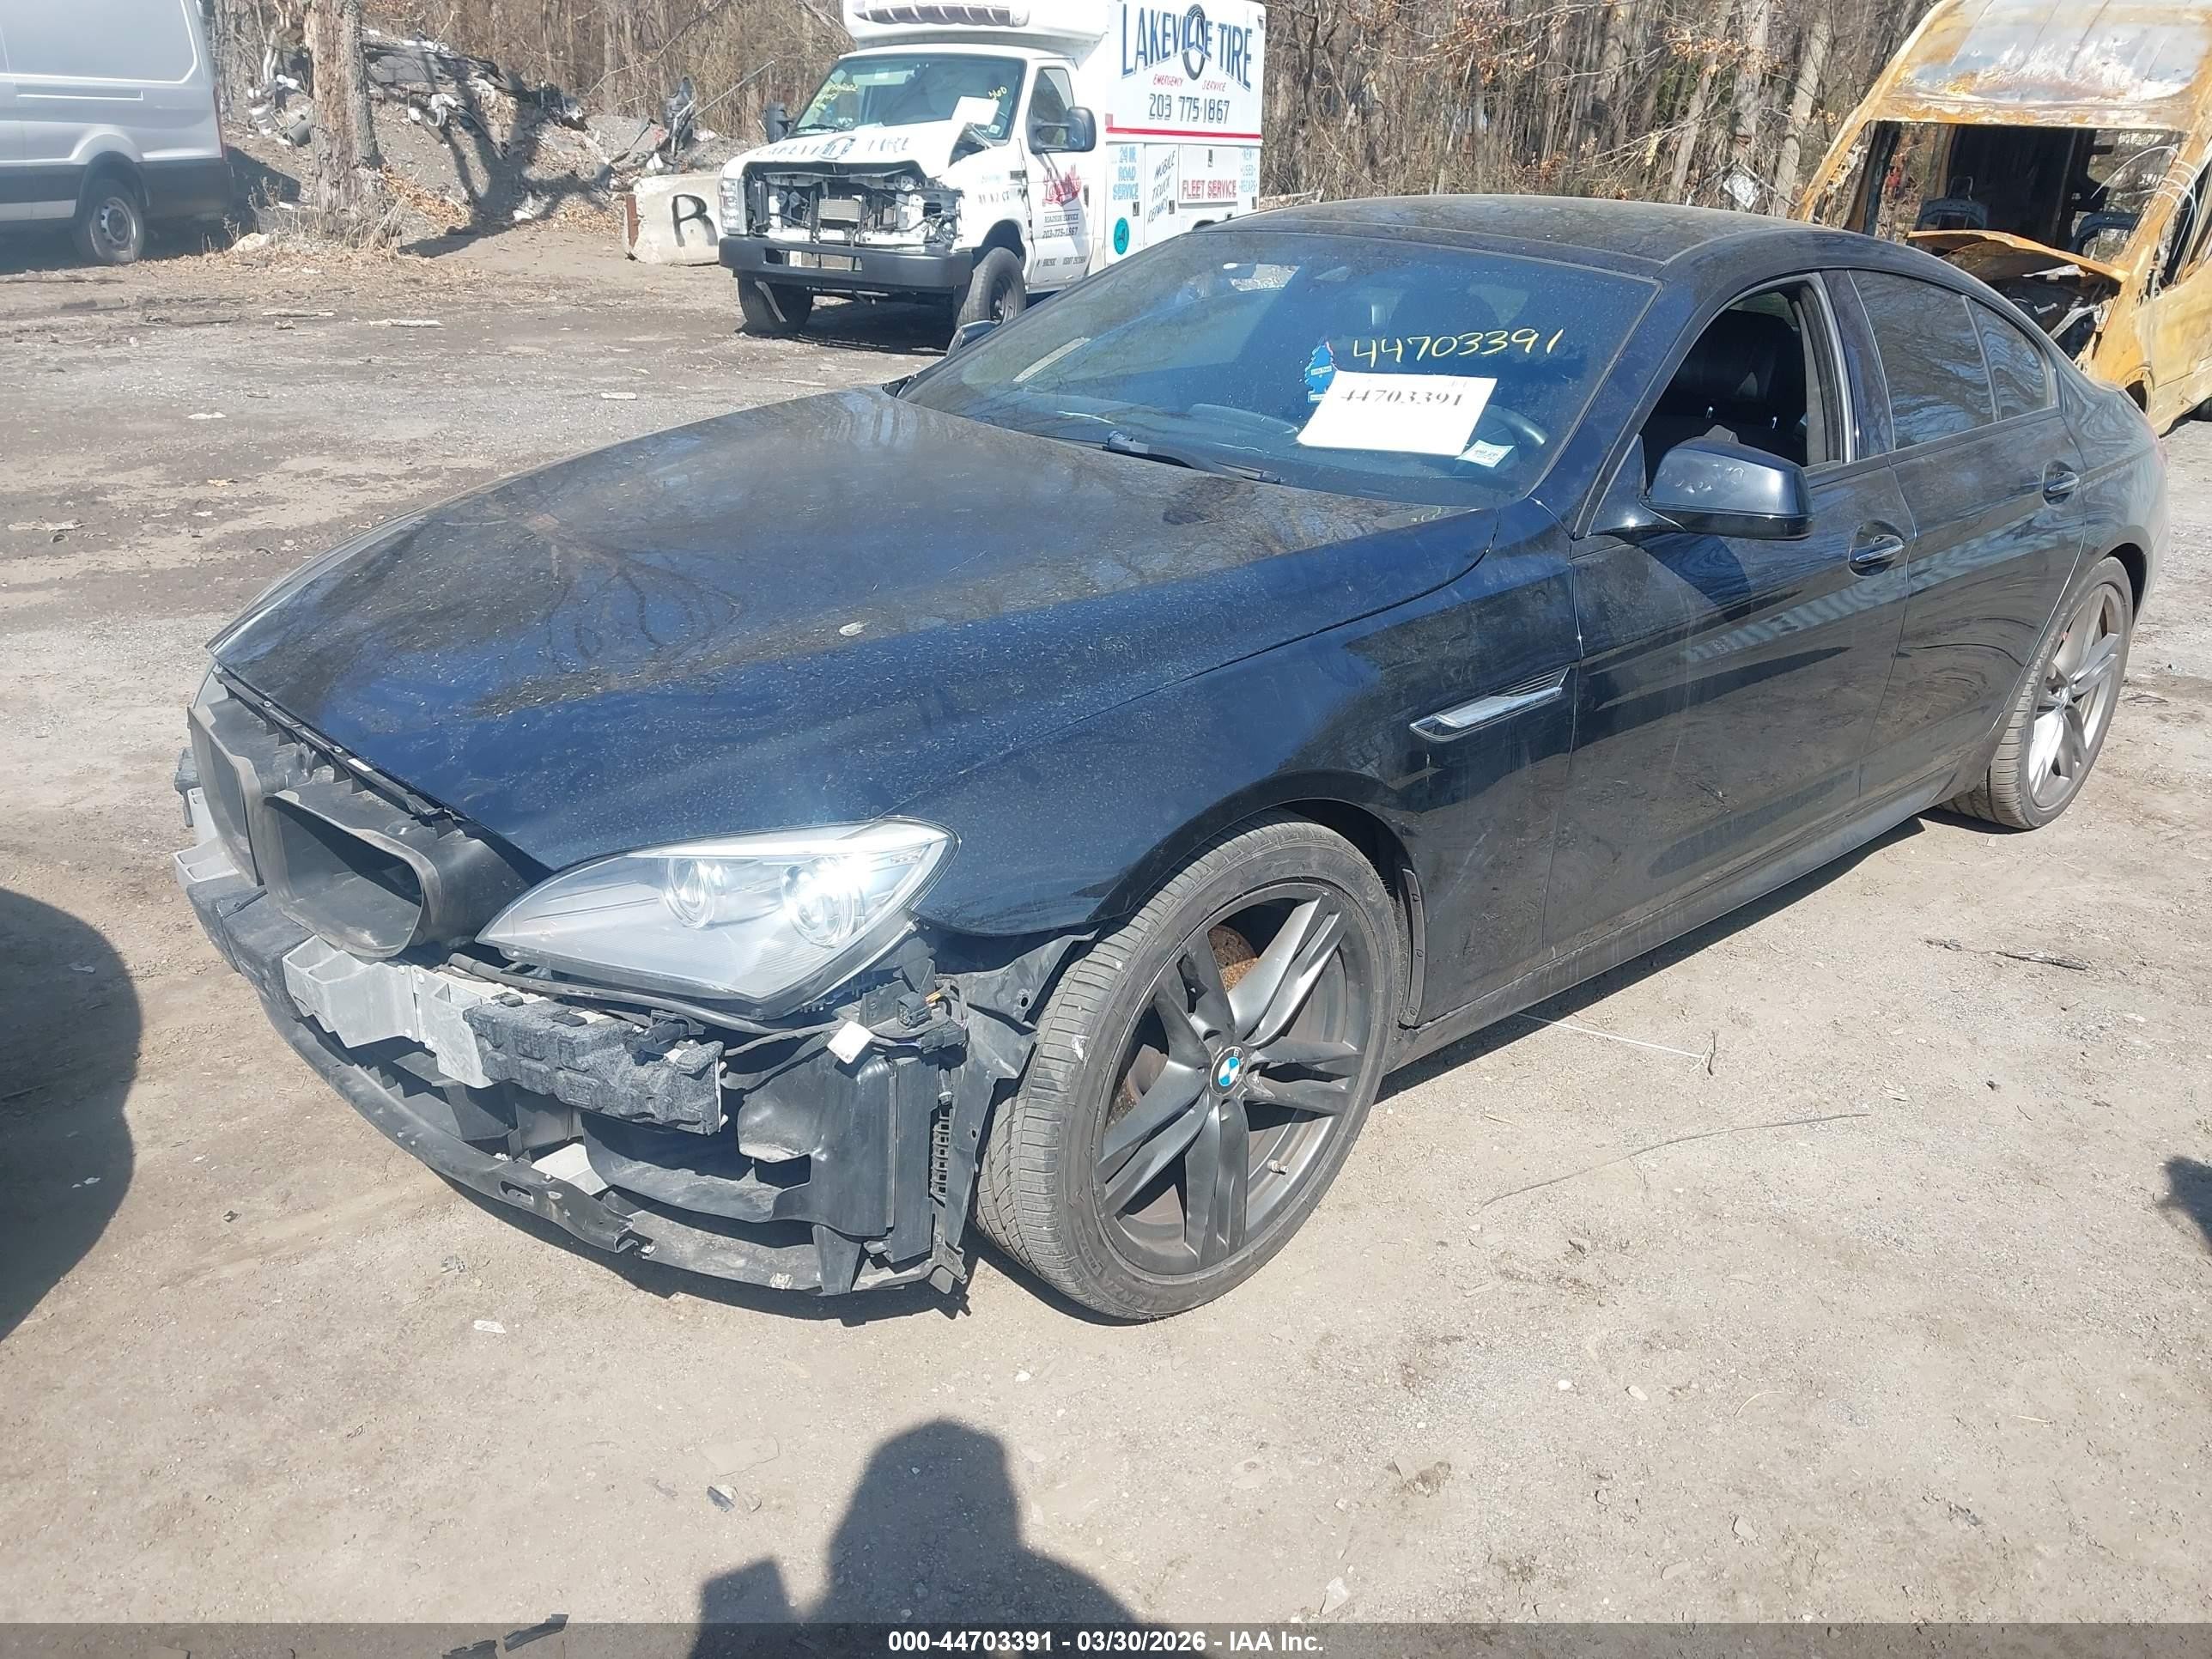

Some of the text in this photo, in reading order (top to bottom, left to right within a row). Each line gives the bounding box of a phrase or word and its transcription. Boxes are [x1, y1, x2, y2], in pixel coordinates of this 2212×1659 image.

[1121, 3, 1252, 92] LAKEVILLE TIRE
[1153, 74, 1226, 92] EMERGENCY SERVICE
[1149, 94, 1172, 120] 203
[1118, 166, 1136, 181] ROAD
[1154, 150, 1176, 180] MOBILE
[1113, 183, 1139, 200] SERVICE
[1152, 175, 1171, 203] TRUCK
[1182, 179, 1237, 199] FLEET SERVICE
[672, 193, 719, 247] R
[1353, 328, 1565, 368] 44703391
[1340, 388, 1463, 406] 44703391
